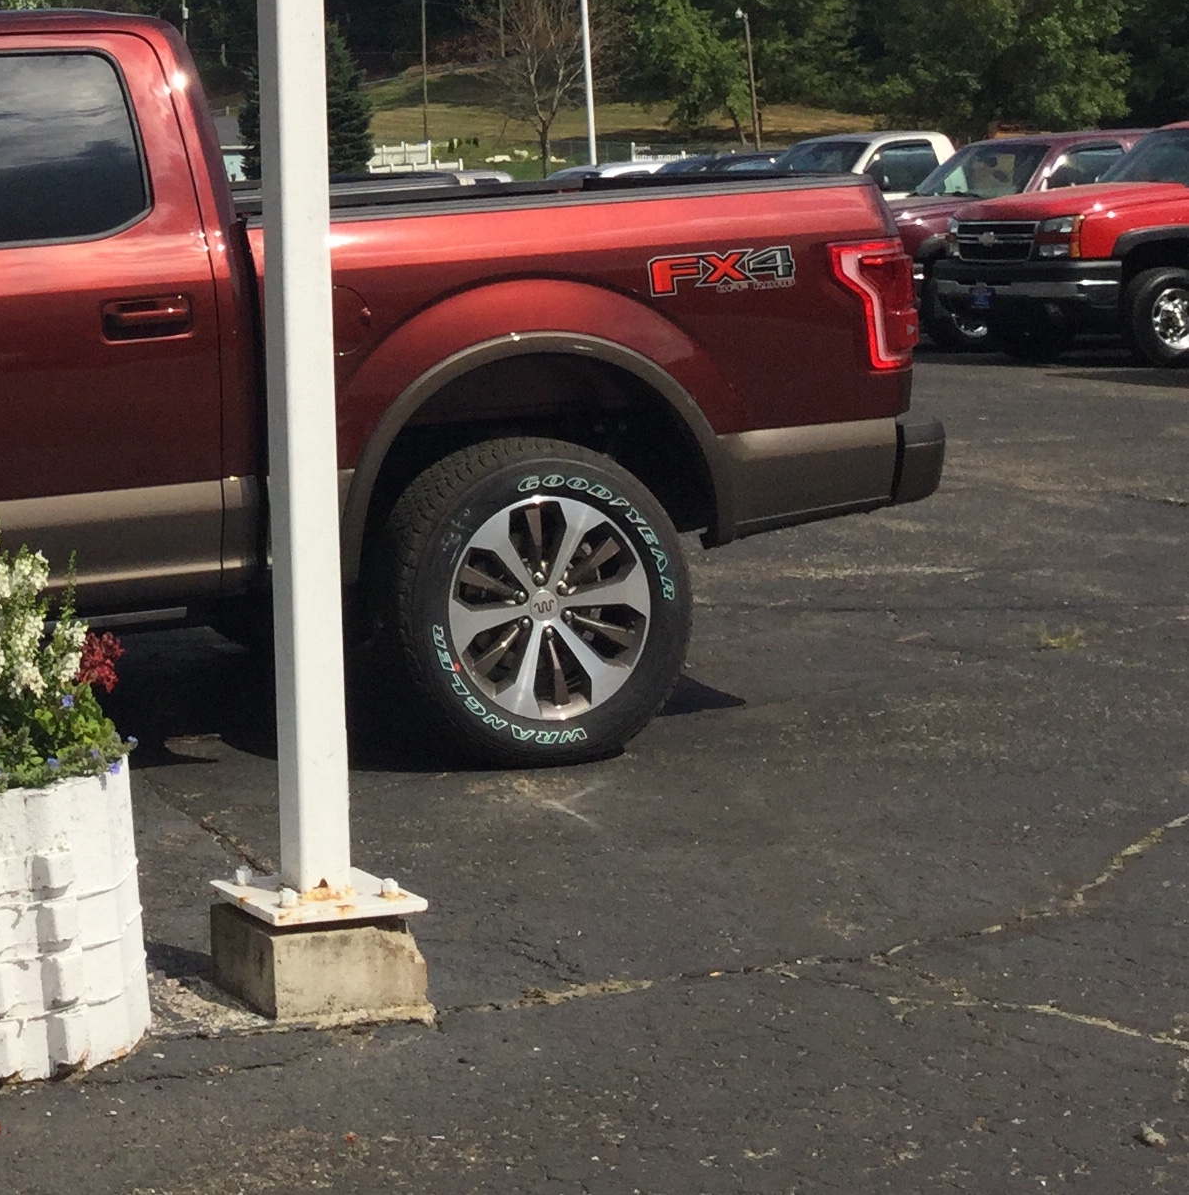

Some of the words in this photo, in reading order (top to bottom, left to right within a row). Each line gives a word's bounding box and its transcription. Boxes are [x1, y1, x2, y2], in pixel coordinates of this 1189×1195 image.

[648, 245, 796, 297] FX4
[517, 474, 675, 601] GOODYEAR
[431, 624, 587, 745] WRANGLER
